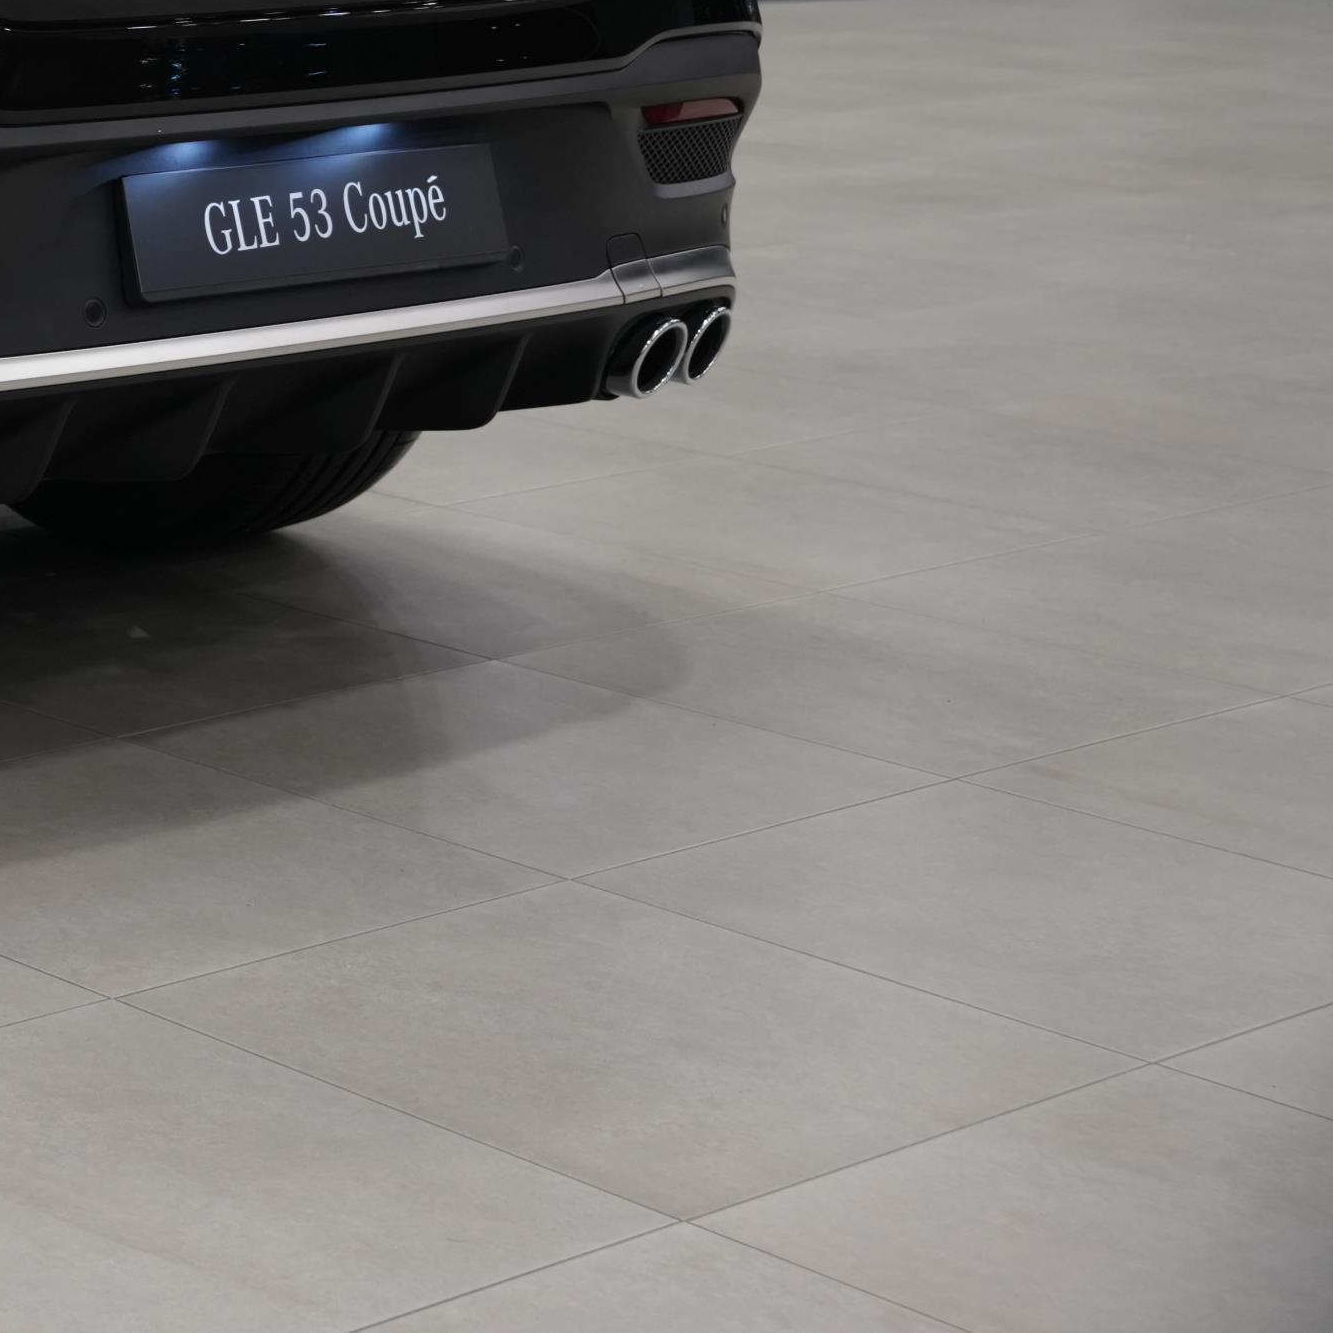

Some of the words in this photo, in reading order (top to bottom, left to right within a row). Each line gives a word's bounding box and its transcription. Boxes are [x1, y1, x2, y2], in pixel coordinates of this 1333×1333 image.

[204, 194, 281, 256] GLE
[289, 188, 334, 243] 53
[342, 175, 447, 239] Coupé
